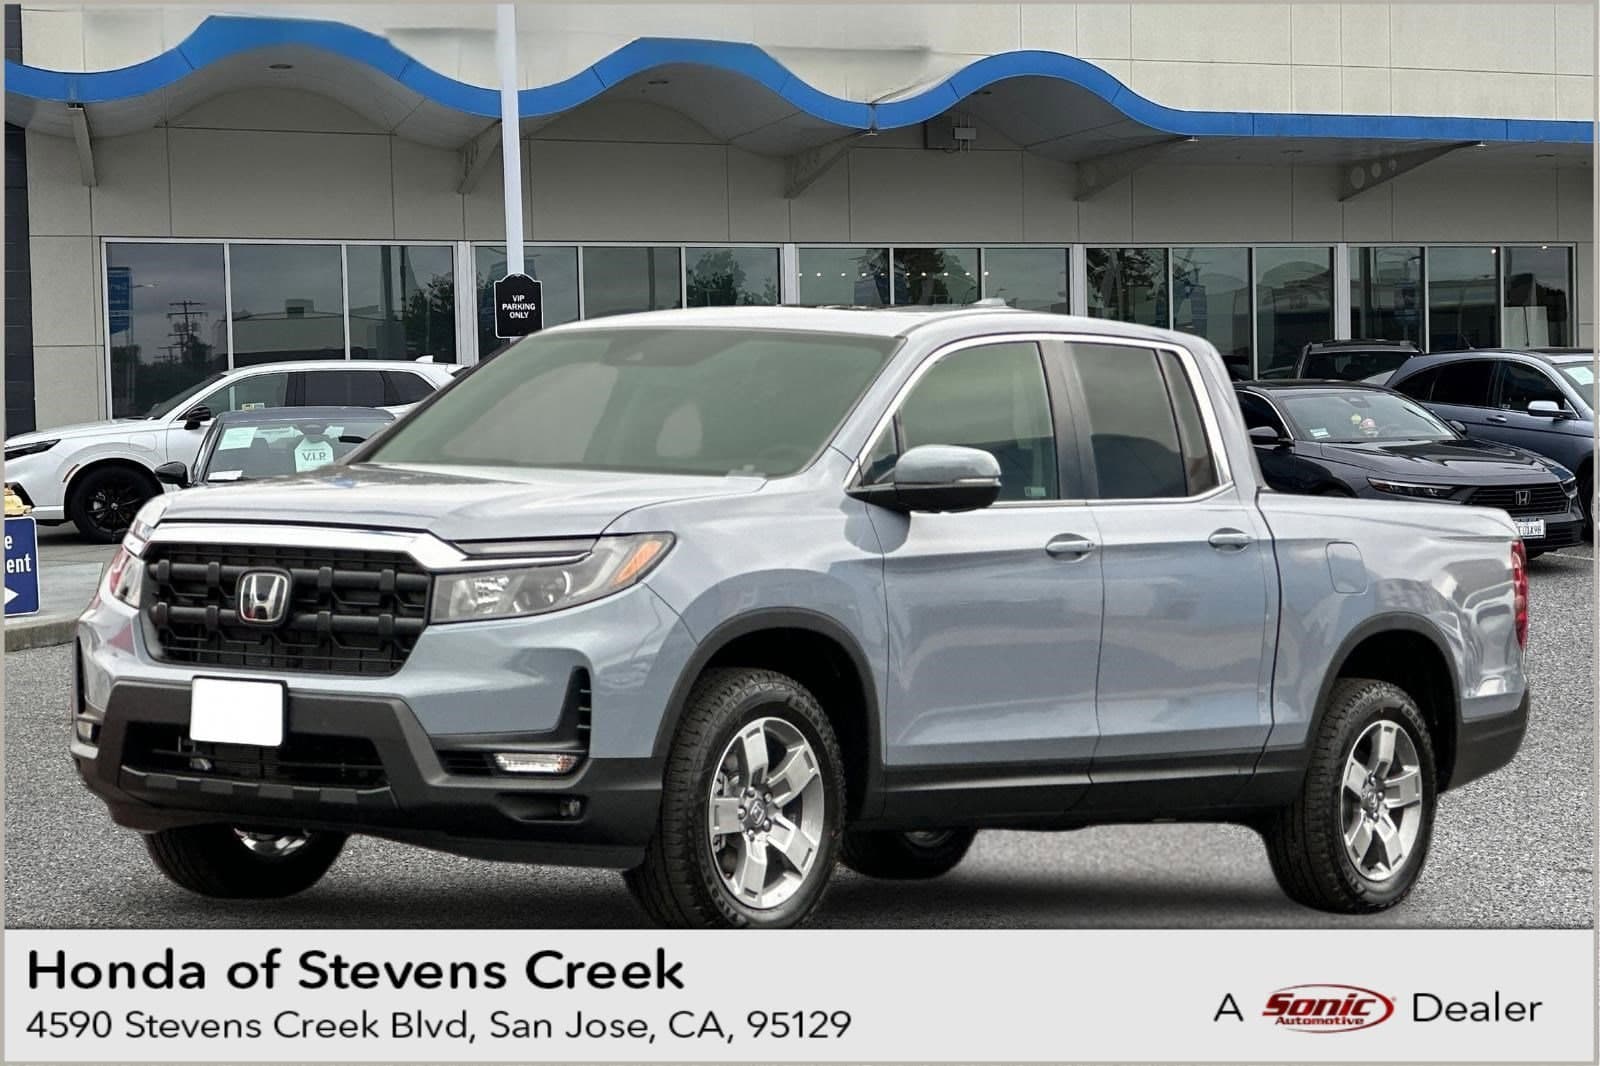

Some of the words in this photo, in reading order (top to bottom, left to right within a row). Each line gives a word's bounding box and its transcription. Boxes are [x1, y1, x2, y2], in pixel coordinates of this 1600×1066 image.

[511, 294, 525, 302] VIP
[501, 303, 536, 311] PARKING
[509, 311, 529, 319] ONLY
